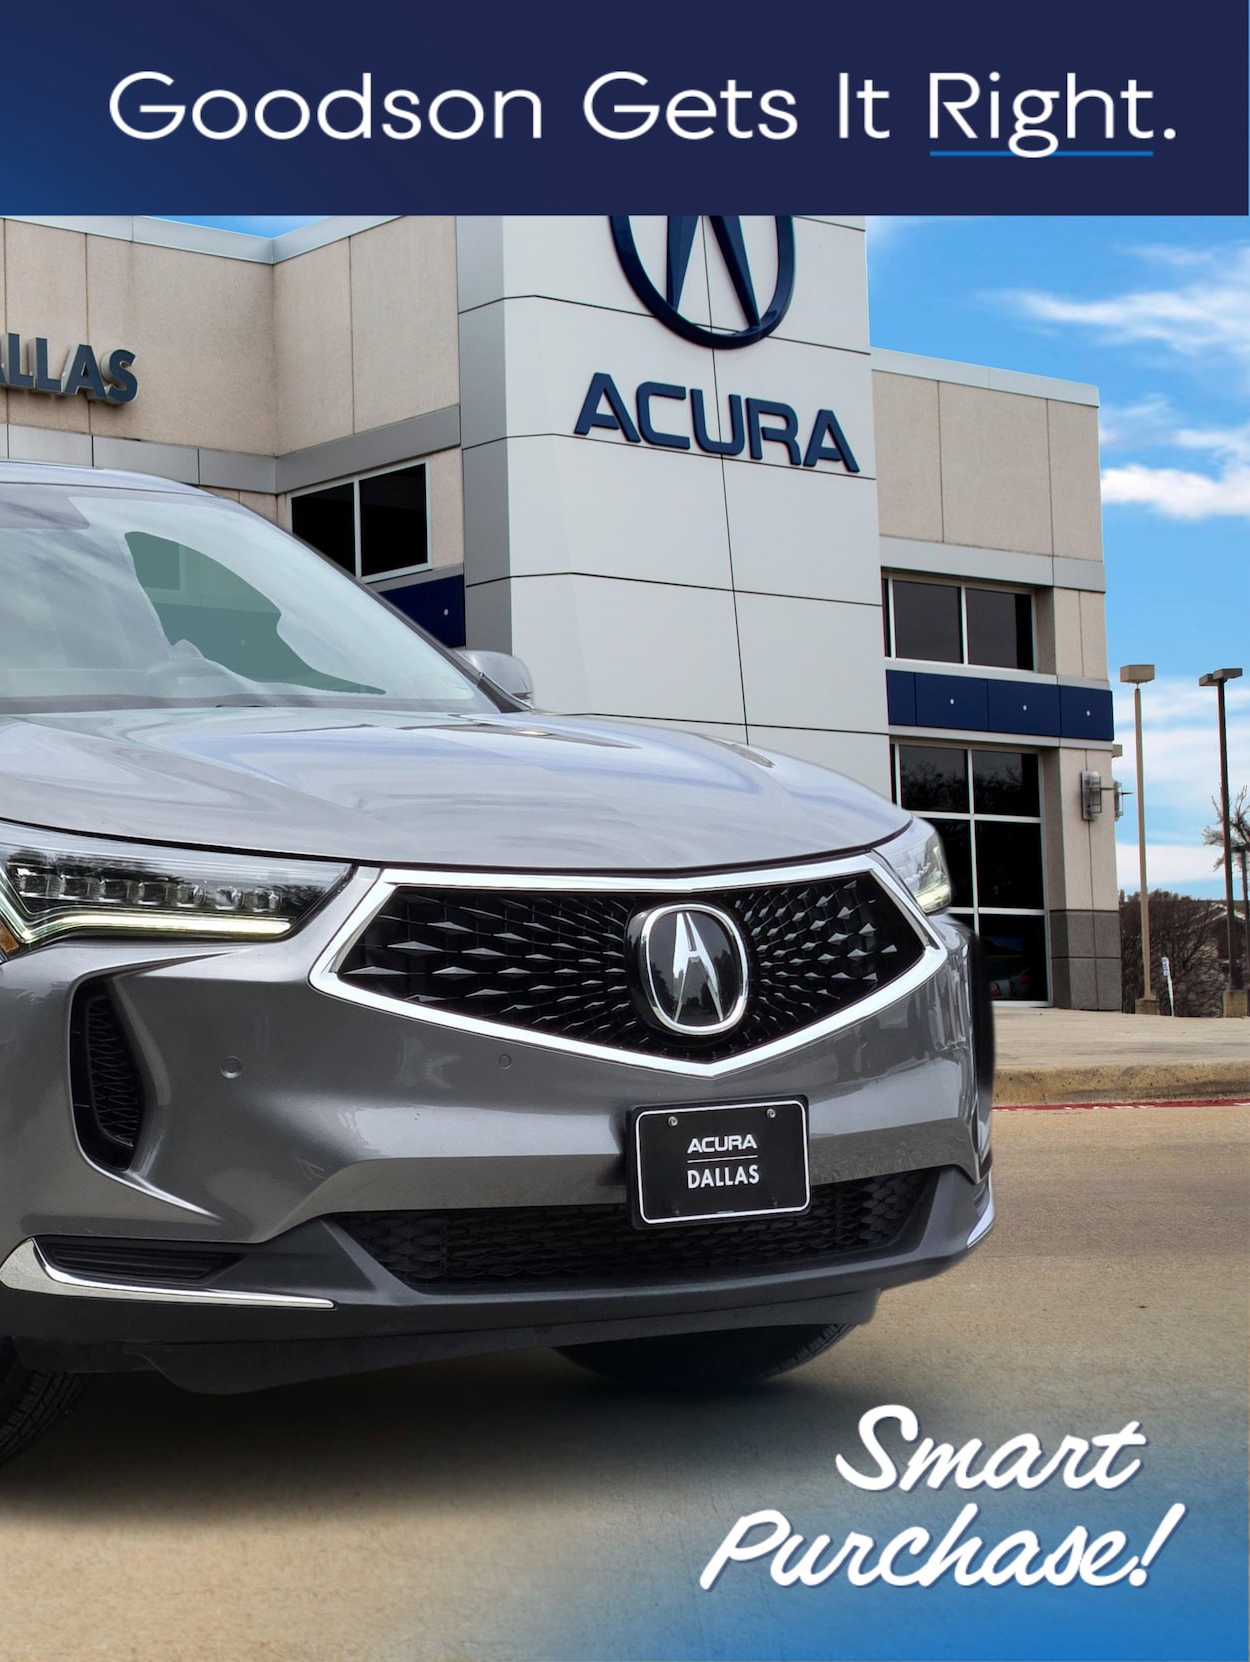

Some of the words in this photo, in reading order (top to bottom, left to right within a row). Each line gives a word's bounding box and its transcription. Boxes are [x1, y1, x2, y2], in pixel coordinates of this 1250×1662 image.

[574, 372, 860, 473] ACURA
[687, 1134, 758, 1153] ACURA
[687, 1164, 760, 1189] DALLAS
